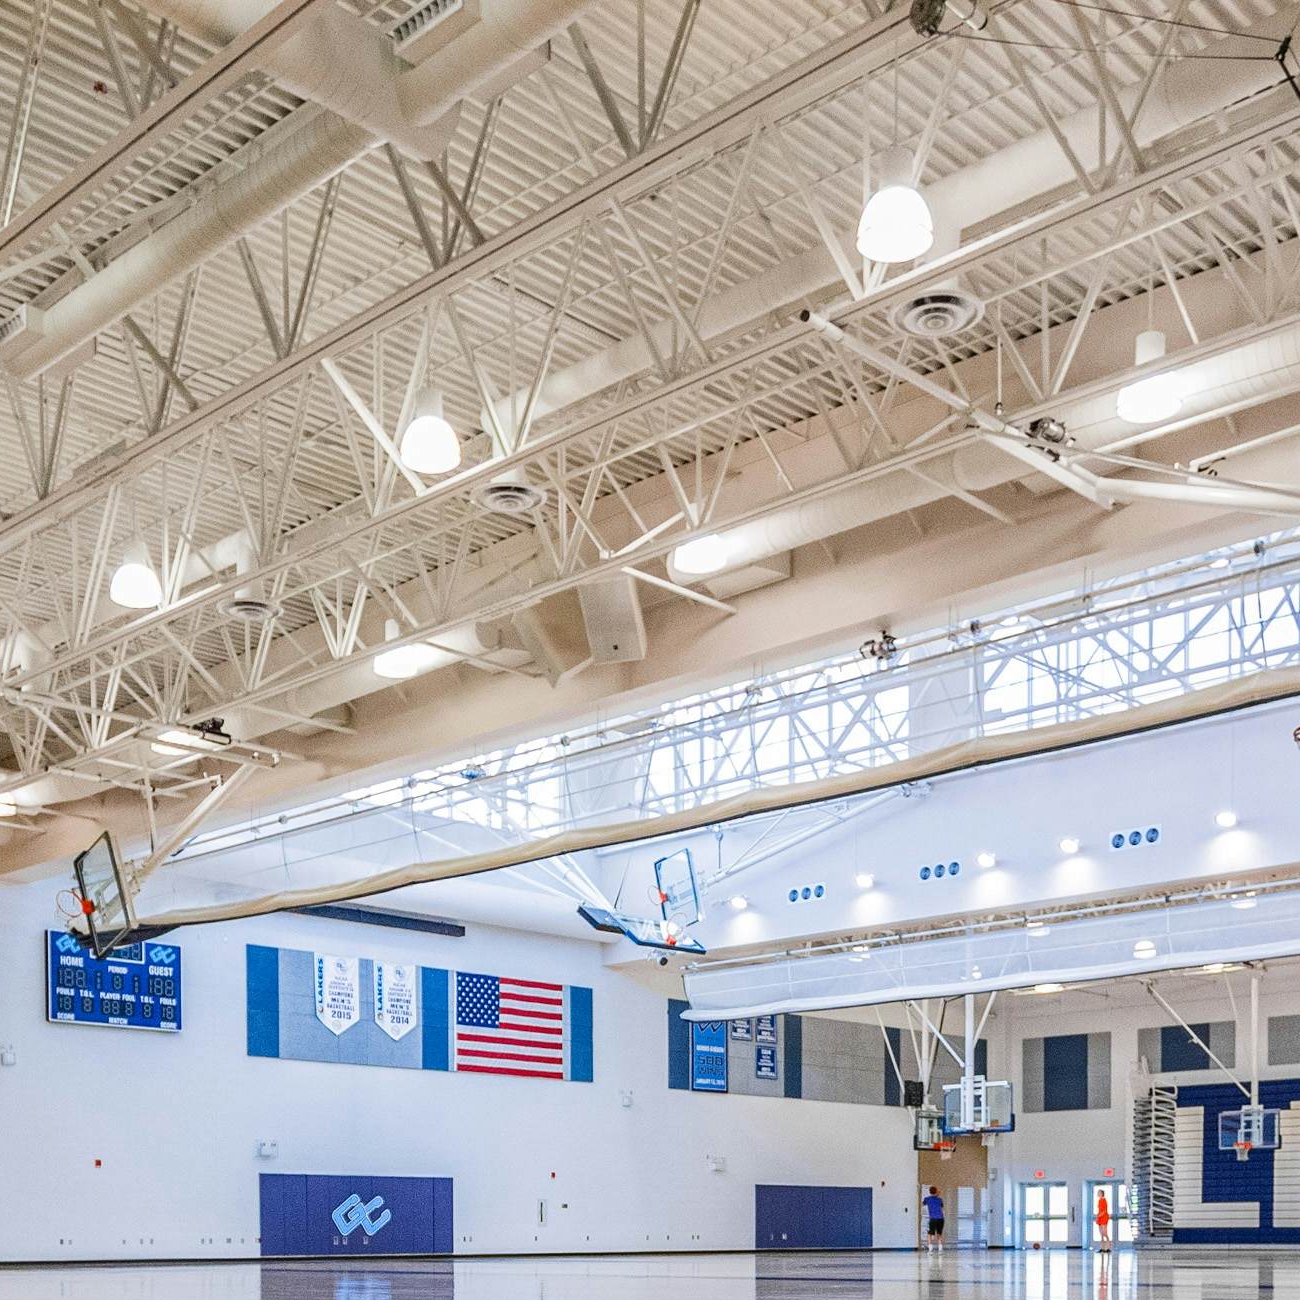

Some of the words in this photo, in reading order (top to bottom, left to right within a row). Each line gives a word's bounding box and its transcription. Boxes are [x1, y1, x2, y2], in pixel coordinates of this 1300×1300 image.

[60, 956, 84, 967] HOME
[108, 966, 128, 974] PERIOD
[148, 965, 174, 976] GUEST
[56, 987, 75, 996] FOULS
[100, 992, 121, 1001] PLAYER
[122, 994, 136, 1002] FOUL
[160, 998, 177, 1006] FOULS
[331, 997, 351, 1005] MEN'S
[390, 1003, 409, 1011] MEN'S
[331, 1010, 351, 1020] 2015
[390, 1015, 409, 1025] 2014
[331, 1194, 391, 1236] GC
